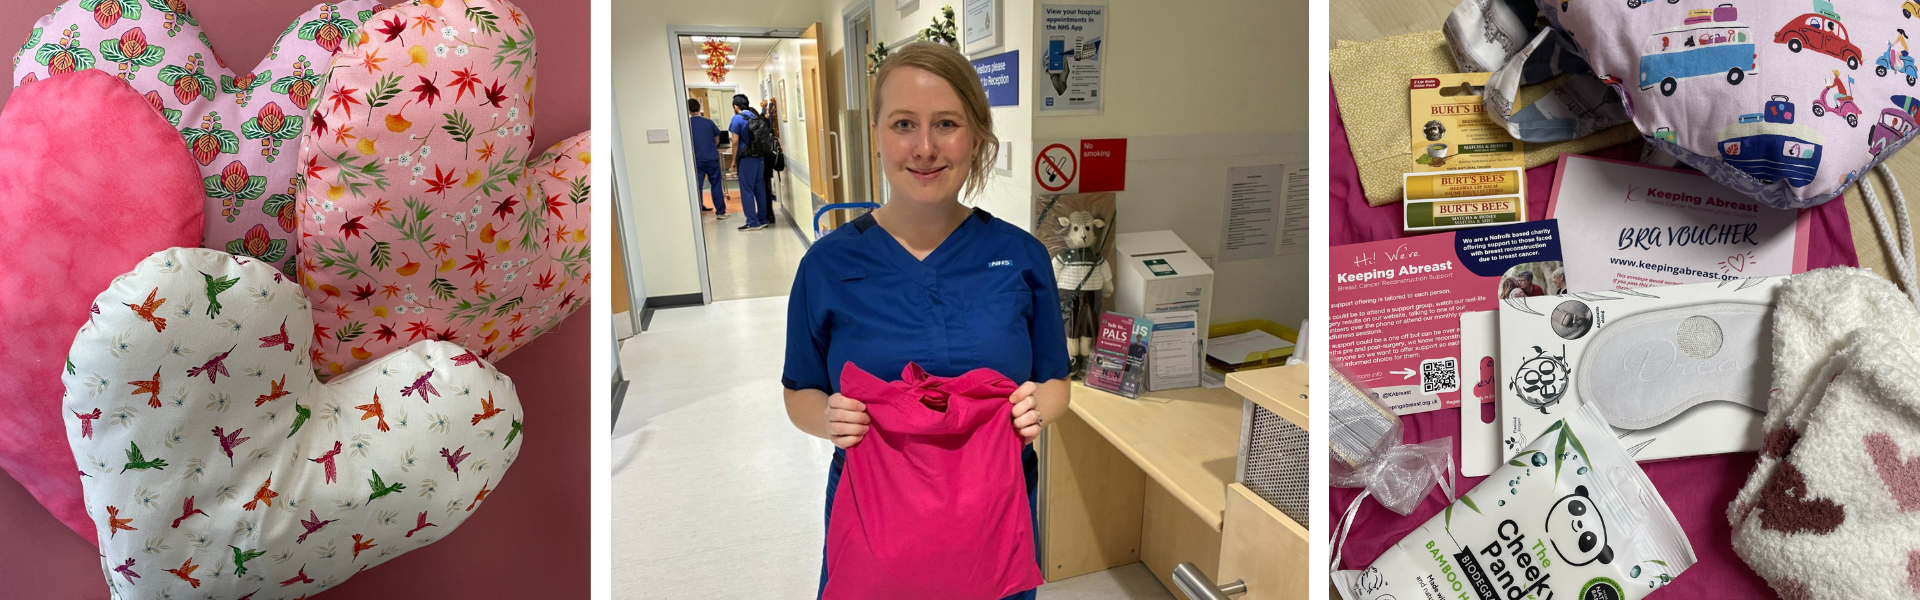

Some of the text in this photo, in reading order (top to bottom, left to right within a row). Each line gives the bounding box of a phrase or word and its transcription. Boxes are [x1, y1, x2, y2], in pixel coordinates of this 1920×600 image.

[977, 64, 991, 74] visitors
[992, 61, 1006, 74] please
[988, 74, 1009, 86] Reception
[1431, 104, 1487, 114] BURT'S BE
[1441, 174, 1505, 185] BURT'S BEES
[1647, 187, 1759, 212] Keeping Abreast
[1440, 202, 1509, 214] BURT'S BEES
[1688, 204, 1732, 216] Reconstruction
[1733, 212, 1757, 220] Support
[1618, 223, 1759, 250] BRA VOUCHER
[1504, 243, 1546, 252] reconstruction
[1354, 244, 1419, 267] Hi! We're
[1338, 260, 1452, 283] Keeping Abreast
[1610, 257, 1750, 281] www.keepingabreast.org
[1382, 276, 1428, 285] Reconstruction
[1429, 272, 1453, 281] Support
[1103, 328, 1128, 341] PALS
[1367, 341, 1406, 351] post-surgery,
[1345, 359, 1371, 367] informed
[1390, 400, 1438, 410] pingabreast.org.uk
[1532, 538, 1550, 568] The
[1425, 540, 1470, 600] BAMBOO H
[1480, 540, 1528, 600] Pand
[1416, 576, 1427, 588] and
[1427, 574, 1439, 593] Made
